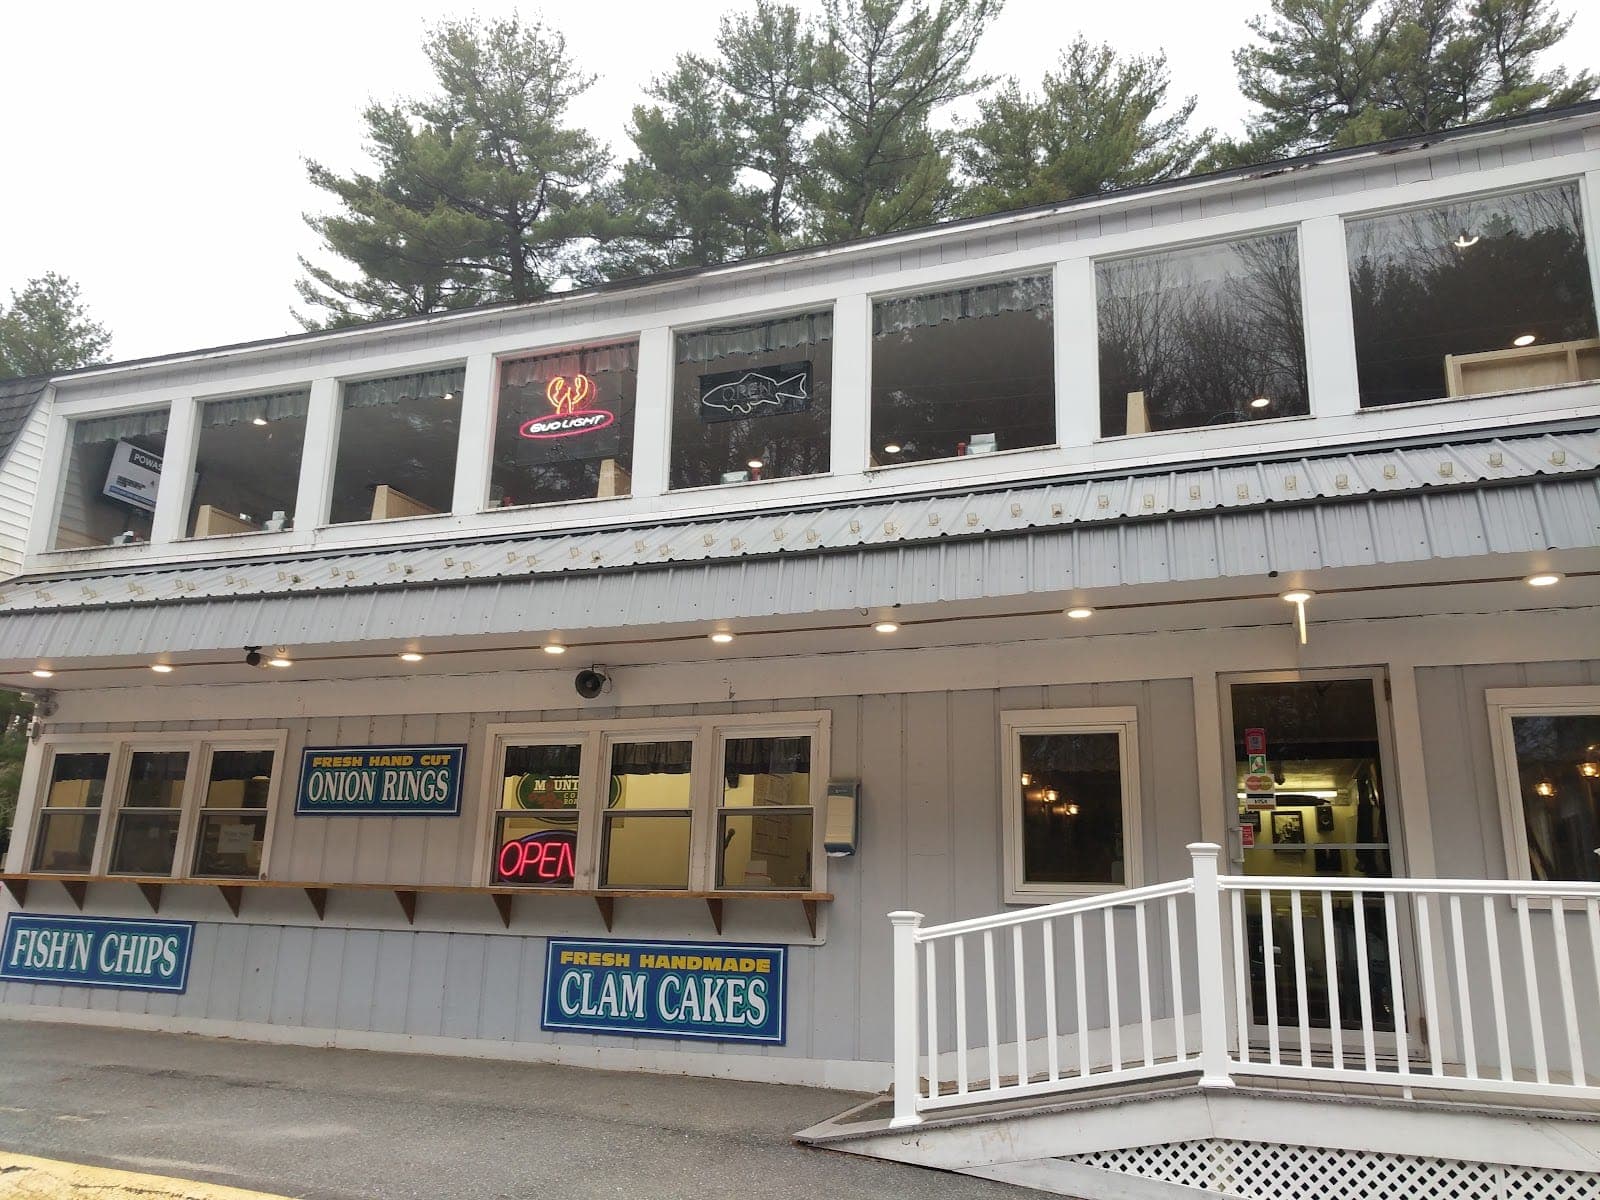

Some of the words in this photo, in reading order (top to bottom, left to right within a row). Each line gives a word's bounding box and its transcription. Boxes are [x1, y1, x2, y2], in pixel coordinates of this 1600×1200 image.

[562, 414, 605, 429] LIGHT
[312, 756, 363, 768] FRESH
[368, 755, 414, 767] HAND
[420, 754, 451, 766] CUT
[308, 771, 376, 802] ONION
[382, 769, 449, 802] RINGS
[499, 841, 575, 877] OPEN
[10, 929, 93, 971] FISH'N
[99, 933, 178, 977] CHIPS
[560, 950, 631, 967] FRESH
[639, 953, 771, 973] HANDMADE
[560, 970, 647, 1018] CLAM
[658, 975, 767, 1026] CAKES
